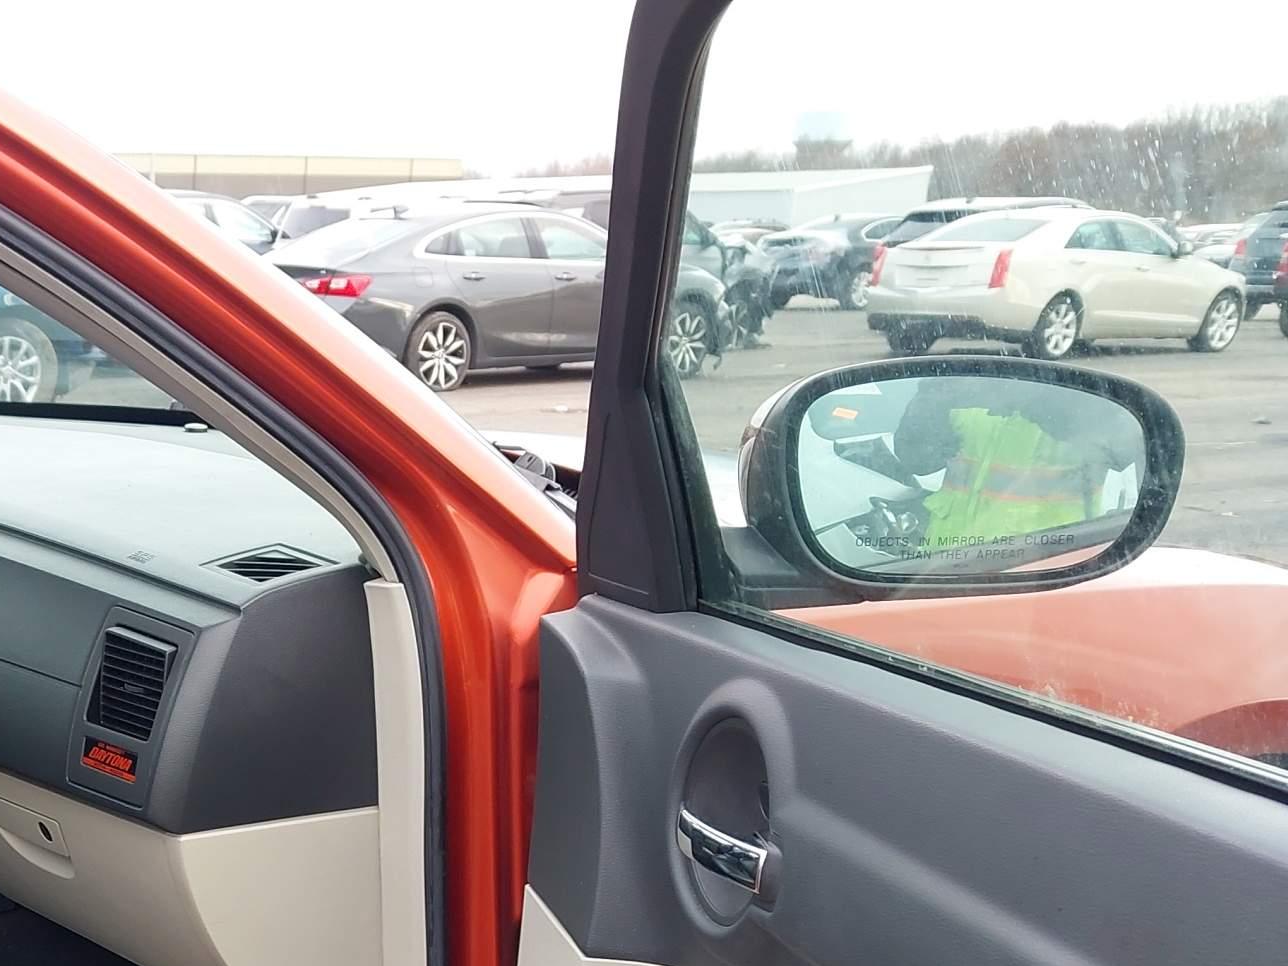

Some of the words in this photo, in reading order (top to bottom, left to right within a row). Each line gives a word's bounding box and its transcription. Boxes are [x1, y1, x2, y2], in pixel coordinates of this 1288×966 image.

[855, 536, 910, 547] OBJECTS
[918, 537, 931, 546] IN
[937, 536, 985, 546] MIRROR
[992, 535, 1016, 545] ARE
[1024, 534, 1075, 545] CLOSER
[900, 549, 932, 560] THAN
[939, 549, 970, 560] THEY
[976, 548, 1026, 560] APPEAR
[88, 746, 133, 771] DAYTONA
